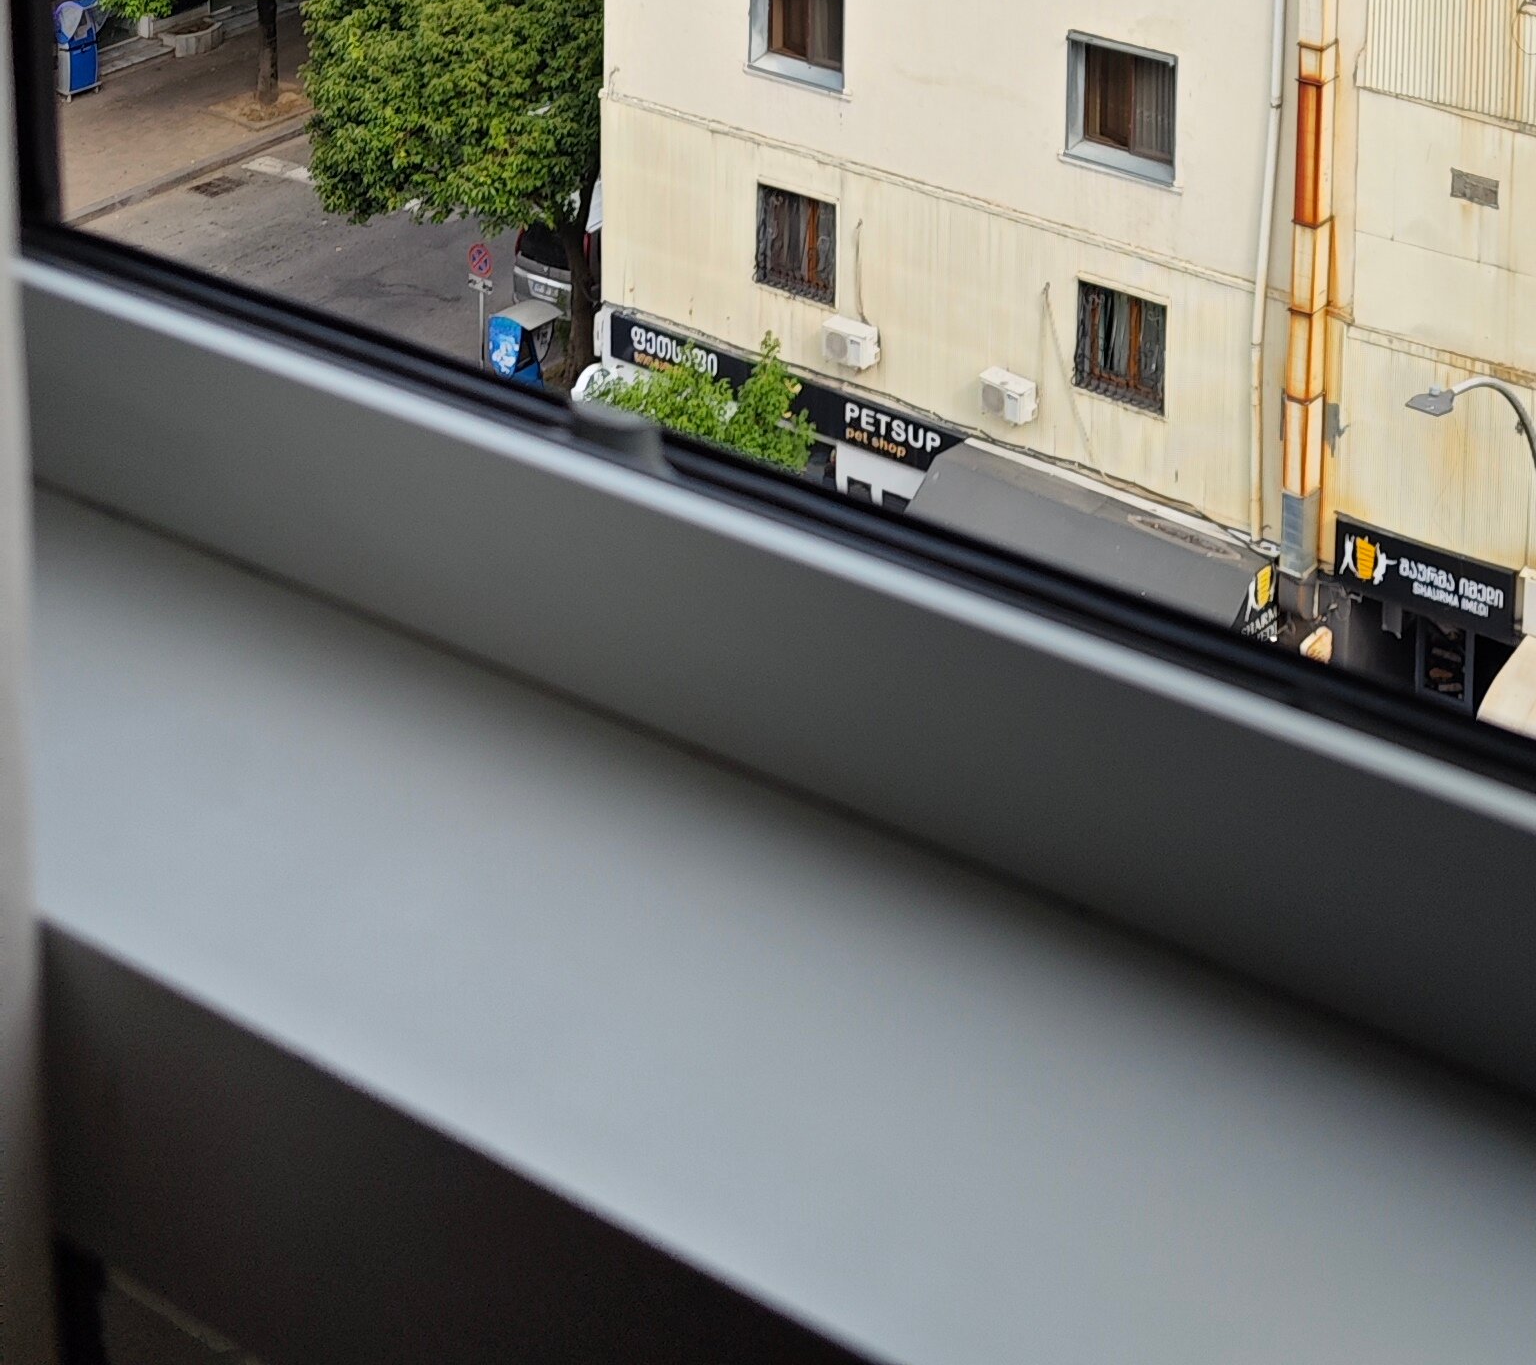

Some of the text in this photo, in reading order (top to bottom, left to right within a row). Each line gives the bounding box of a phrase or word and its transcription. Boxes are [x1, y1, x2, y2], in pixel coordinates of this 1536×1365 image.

[844, 401, 941, 452] PETSUP
[845, 427, 907, 458] pet shop
[1412, 581, 1460, 608] SHAURMA
